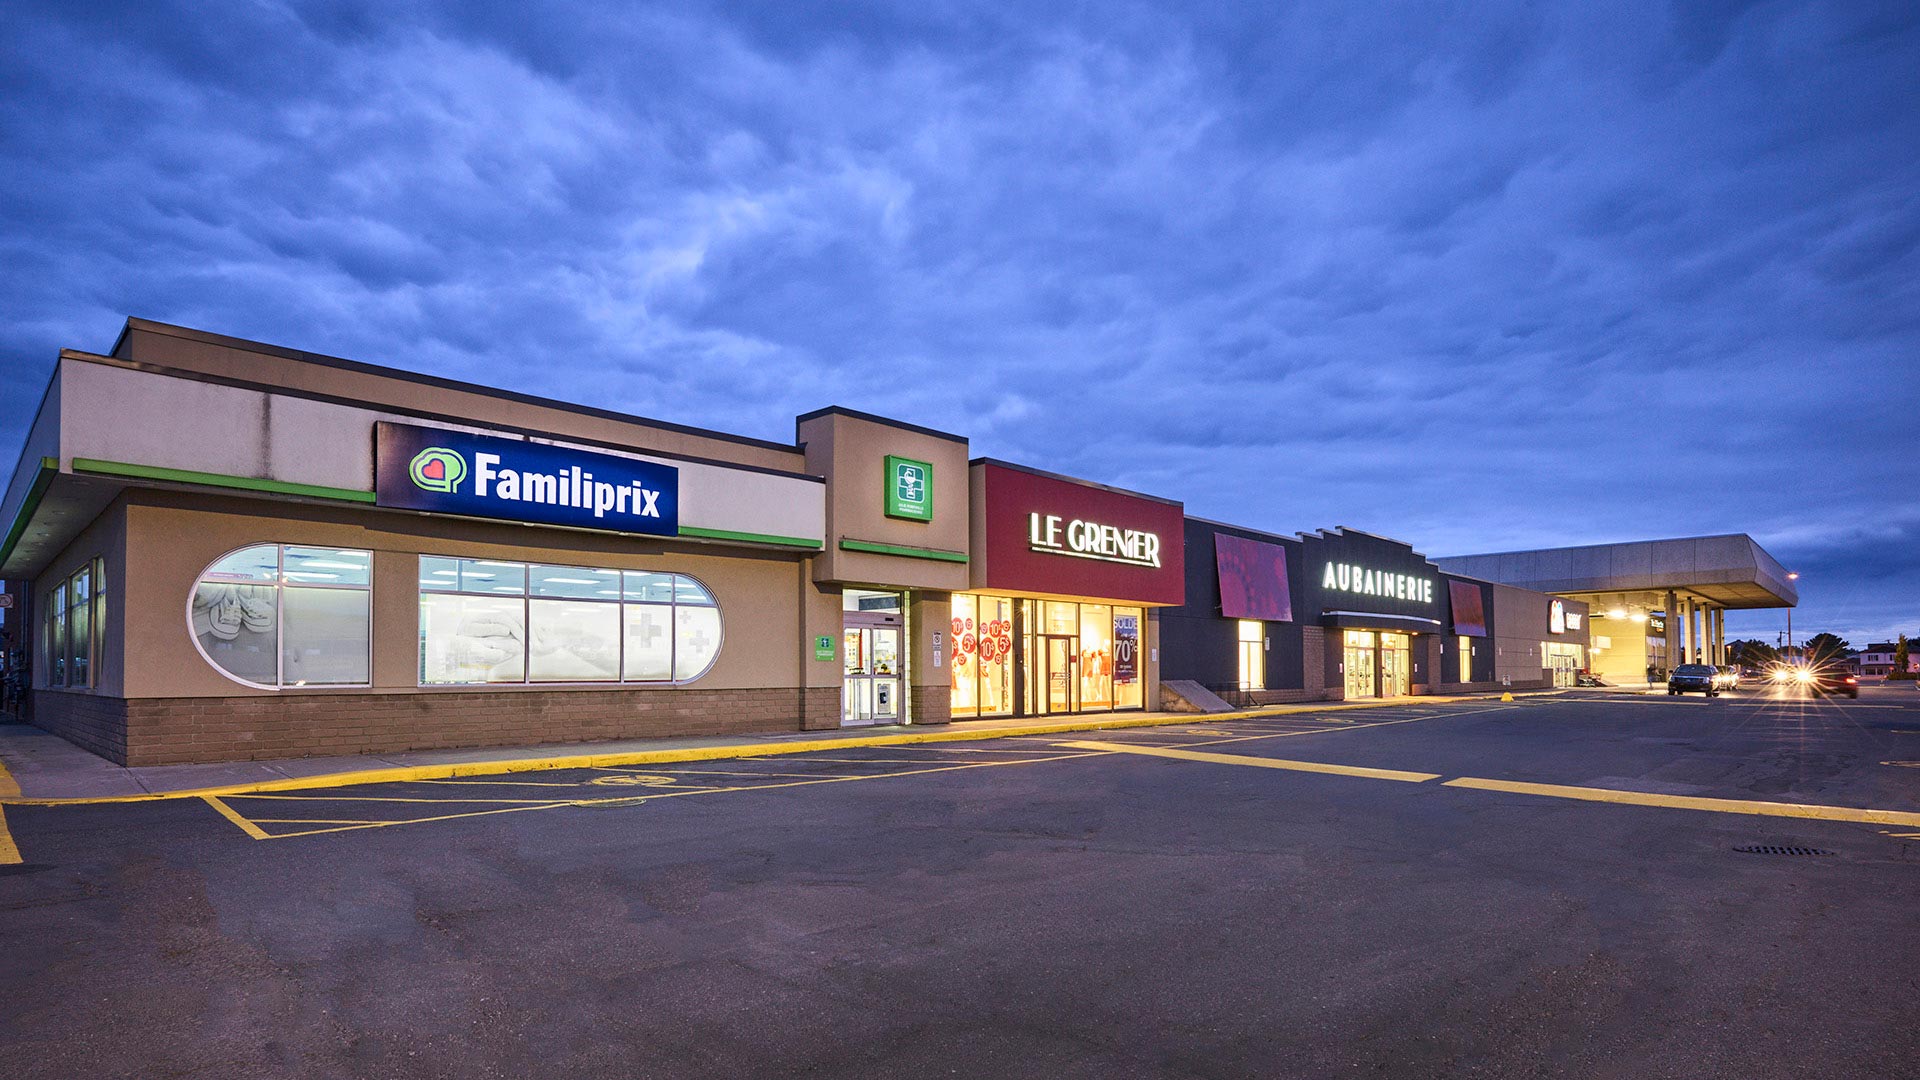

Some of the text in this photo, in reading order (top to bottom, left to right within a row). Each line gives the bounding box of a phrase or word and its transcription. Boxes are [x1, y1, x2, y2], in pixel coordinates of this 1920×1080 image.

[475, 452, 660, 518] Familiprix
[1030, 512, 1161, 568] LE GRENIER
[1322, 561, 1432, 603] AUBAINERIE
[1115, 639, 1138, 662] 70%
